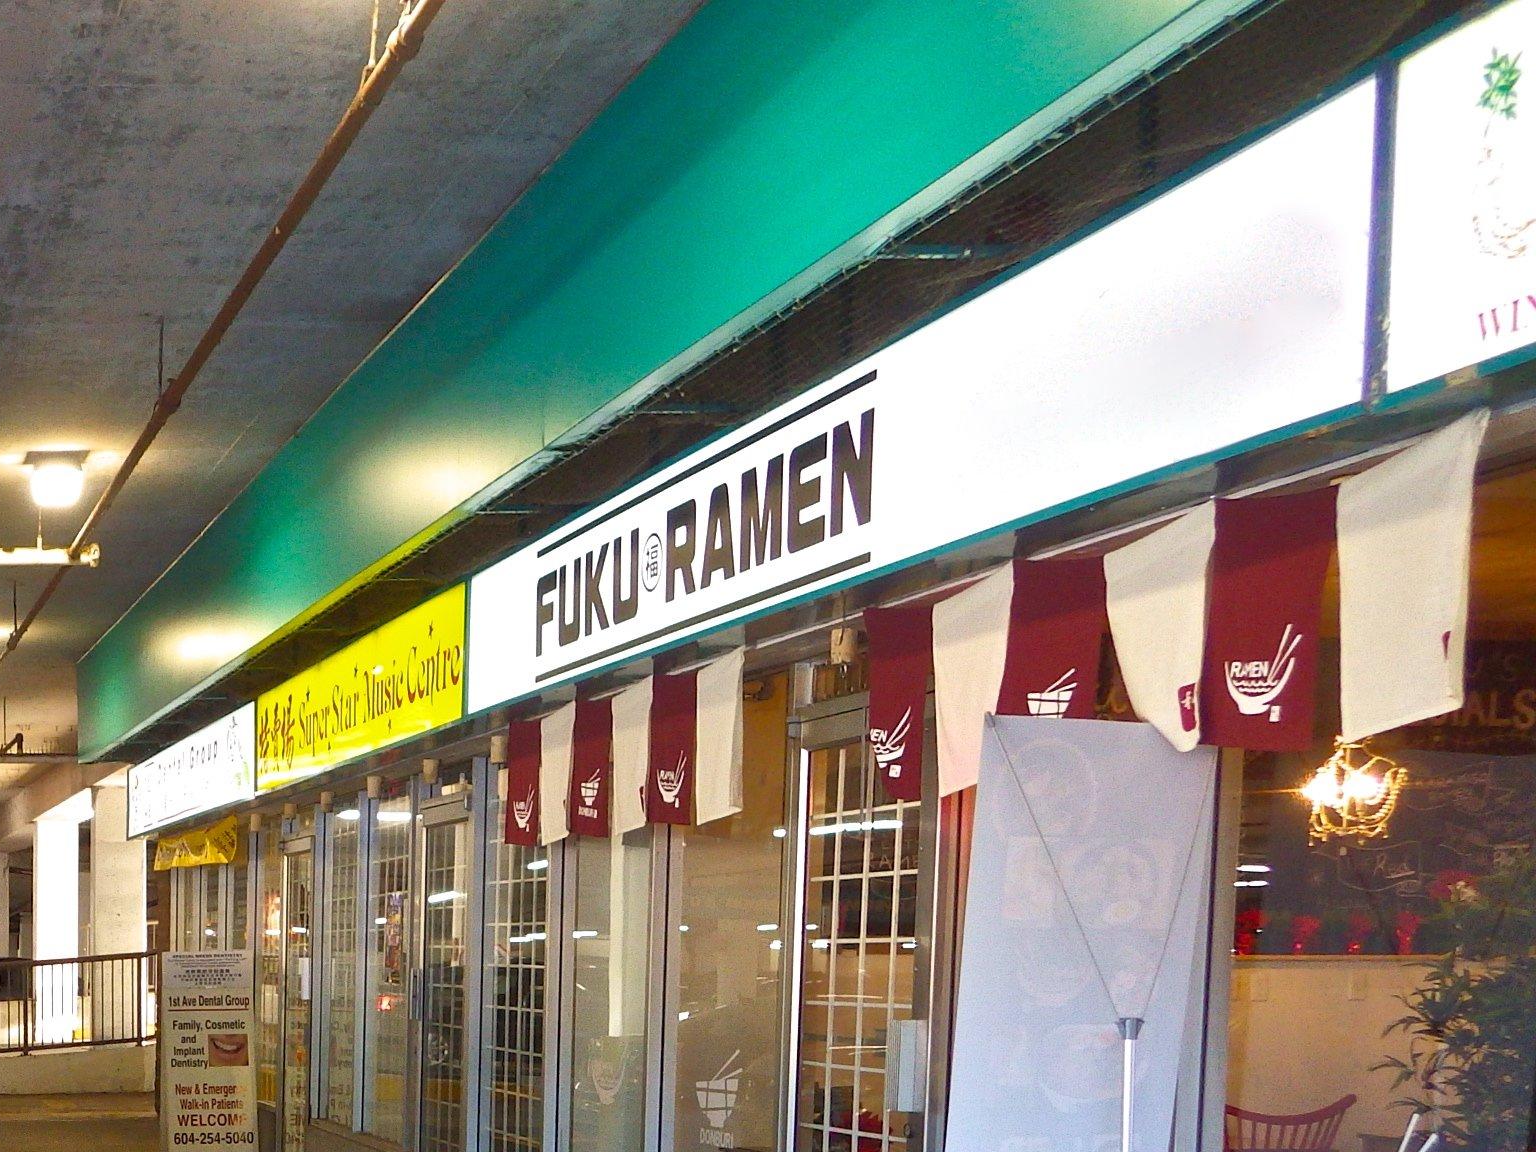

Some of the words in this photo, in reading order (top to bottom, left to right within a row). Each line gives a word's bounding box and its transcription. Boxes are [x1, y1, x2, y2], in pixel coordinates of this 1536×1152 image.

[535, 527, 640, 658] FUKU
[665, 407, 875, 603] RAMEN
[299, 701, 330, 757] Super
[332, 685, 359, 735] Star
[363, 661, 403, 723] Music
[406, 641, 461, 706] Centre
[169, 996, 181, 1008] 1st
[182, 996, 197, 1007] Ave
[198, 995, 224, 1007] Dental
[225, 995, 250, 1009] Group
[172, 1020, 203, 1033] Family,
[205, 1019, 246, 1030] Cosmetic
[181, 1034, 197, 1044] and
[173, 1046, 205, 1057] Implant
[171, 1058, 209, 1070] Dentistry
[175, 1083, 192, 1096] New
[195, 1083, 200, 1095] &
[179, 1099, 210, 1110] Walk-in
[174, 1131, 254, 1145] 604-254-5040
